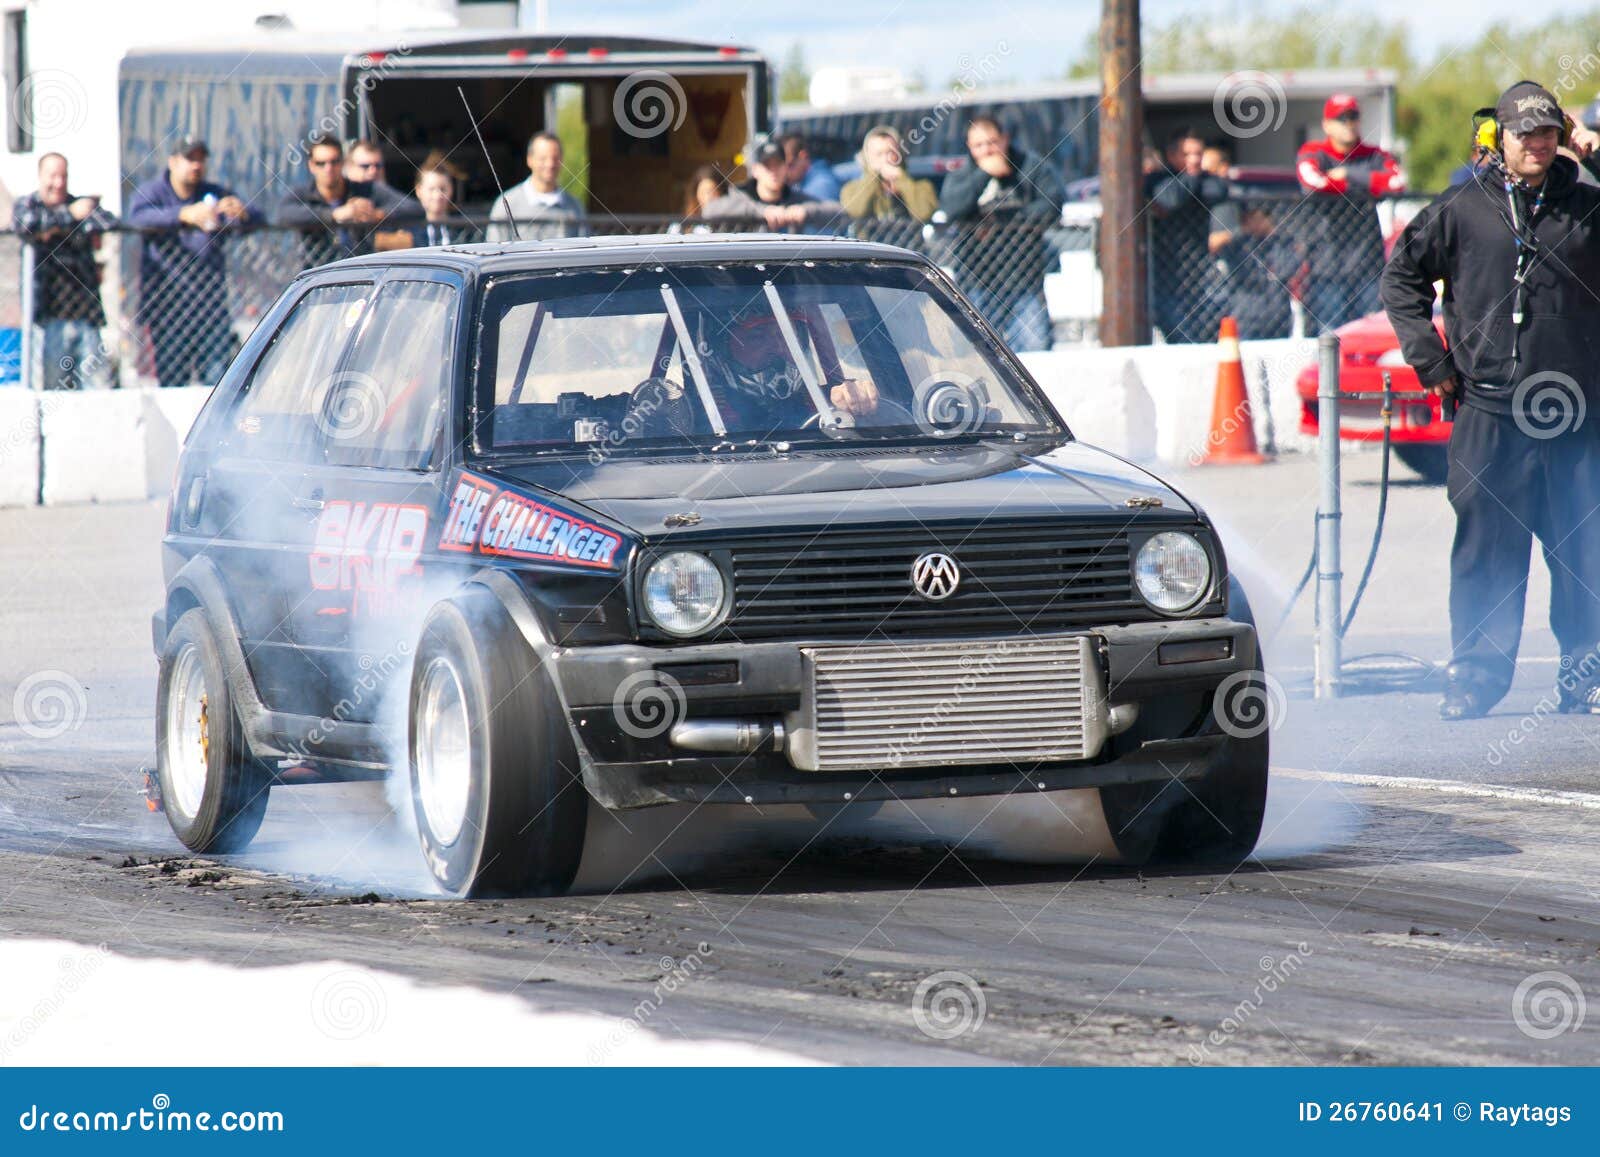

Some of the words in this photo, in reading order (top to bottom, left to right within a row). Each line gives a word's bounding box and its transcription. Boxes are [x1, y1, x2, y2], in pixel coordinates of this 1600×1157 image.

[309, 500, 429, 591] SKIP
[440, 479, 494, 548] THE
[481, 496, 619, 564] CHALLENGER
